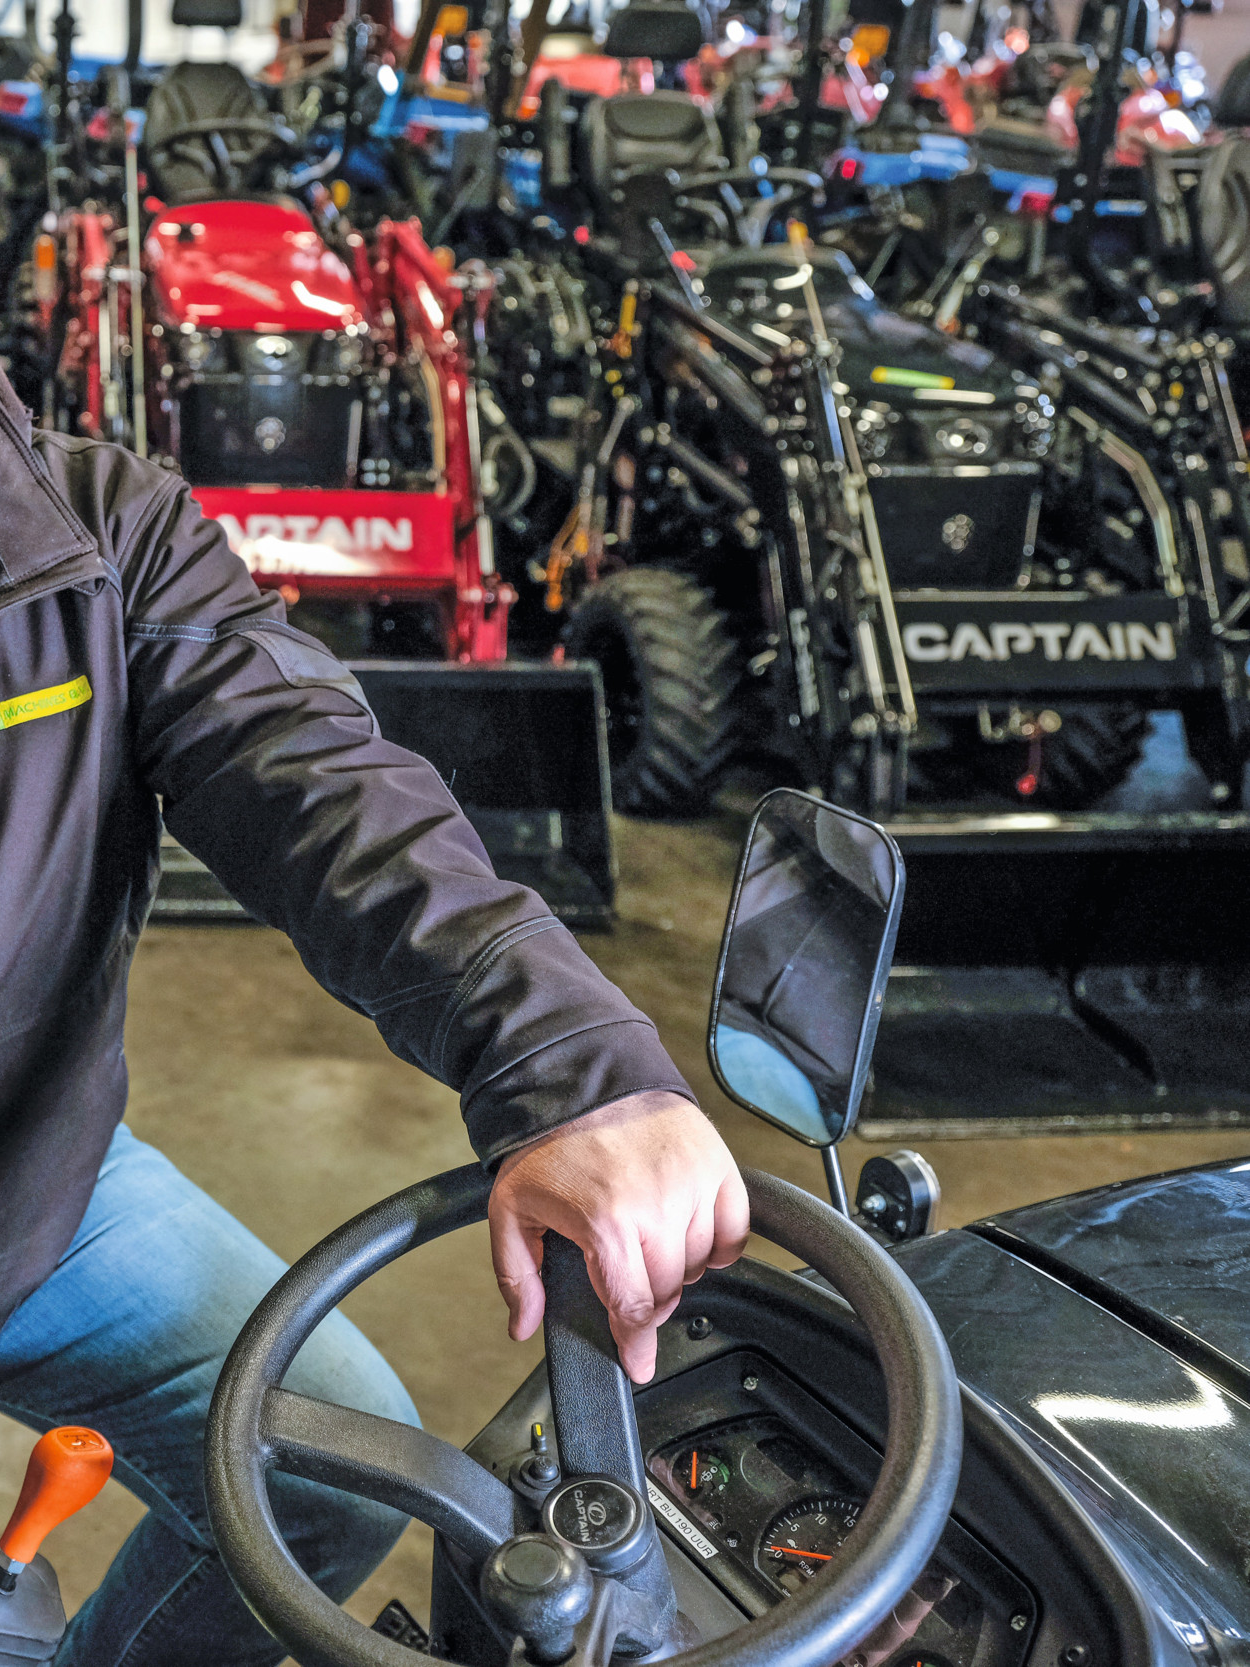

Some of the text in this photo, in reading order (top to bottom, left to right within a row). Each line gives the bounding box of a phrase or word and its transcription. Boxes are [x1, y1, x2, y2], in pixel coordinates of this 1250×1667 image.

[216, 514, 413, 551] APTAIN
[902, 622, 1177, 662] CAPTAIN
[574, 1490, 592, 1543] CAPTAIN
[791, 1523, 800, 1532] 5
[815, 1513, 828, 1525] 10
[843, 1515, 856, 1528] 15
[660, 1503, 676, 1517] BIJ
[675, 1518, 692, 1534] 190
[690, 1535, 713, 1556] UUR
[774, 1550, 783, 1559] 0
